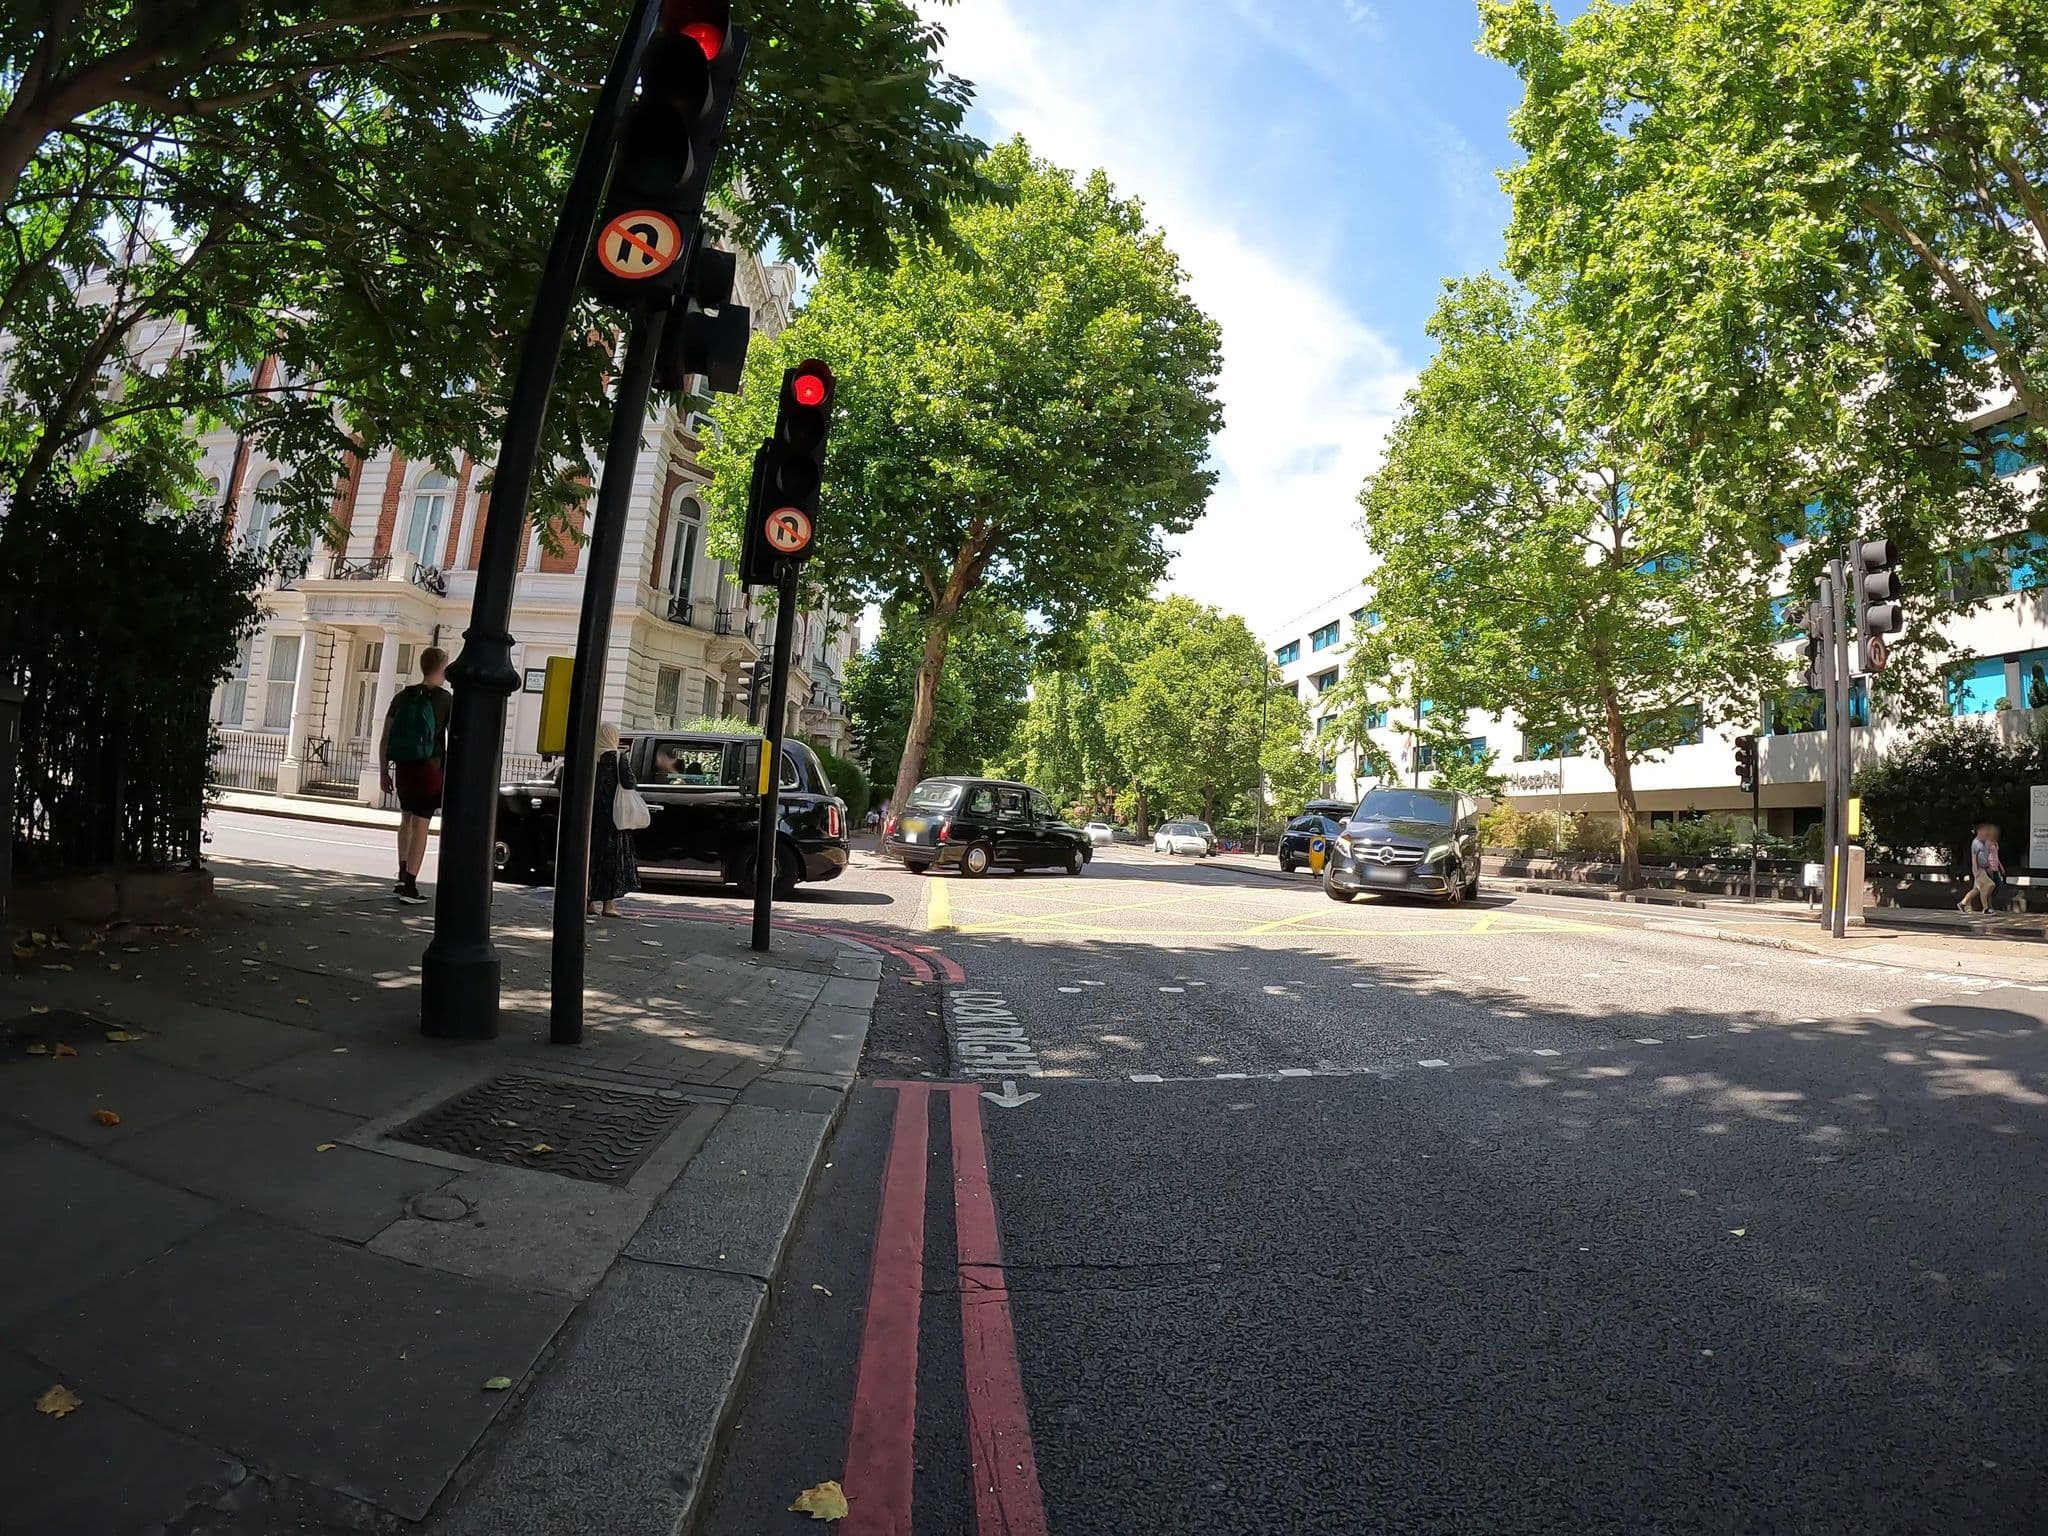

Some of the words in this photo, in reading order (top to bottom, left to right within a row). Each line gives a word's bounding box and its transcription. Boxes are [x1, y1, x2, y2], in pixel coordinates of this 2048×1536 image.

[1511, 770, 1564, 793] Hospital
[949, 990, 1020, 1025] LOOK
[956, 1027, 1041, 1078] RIGHT
